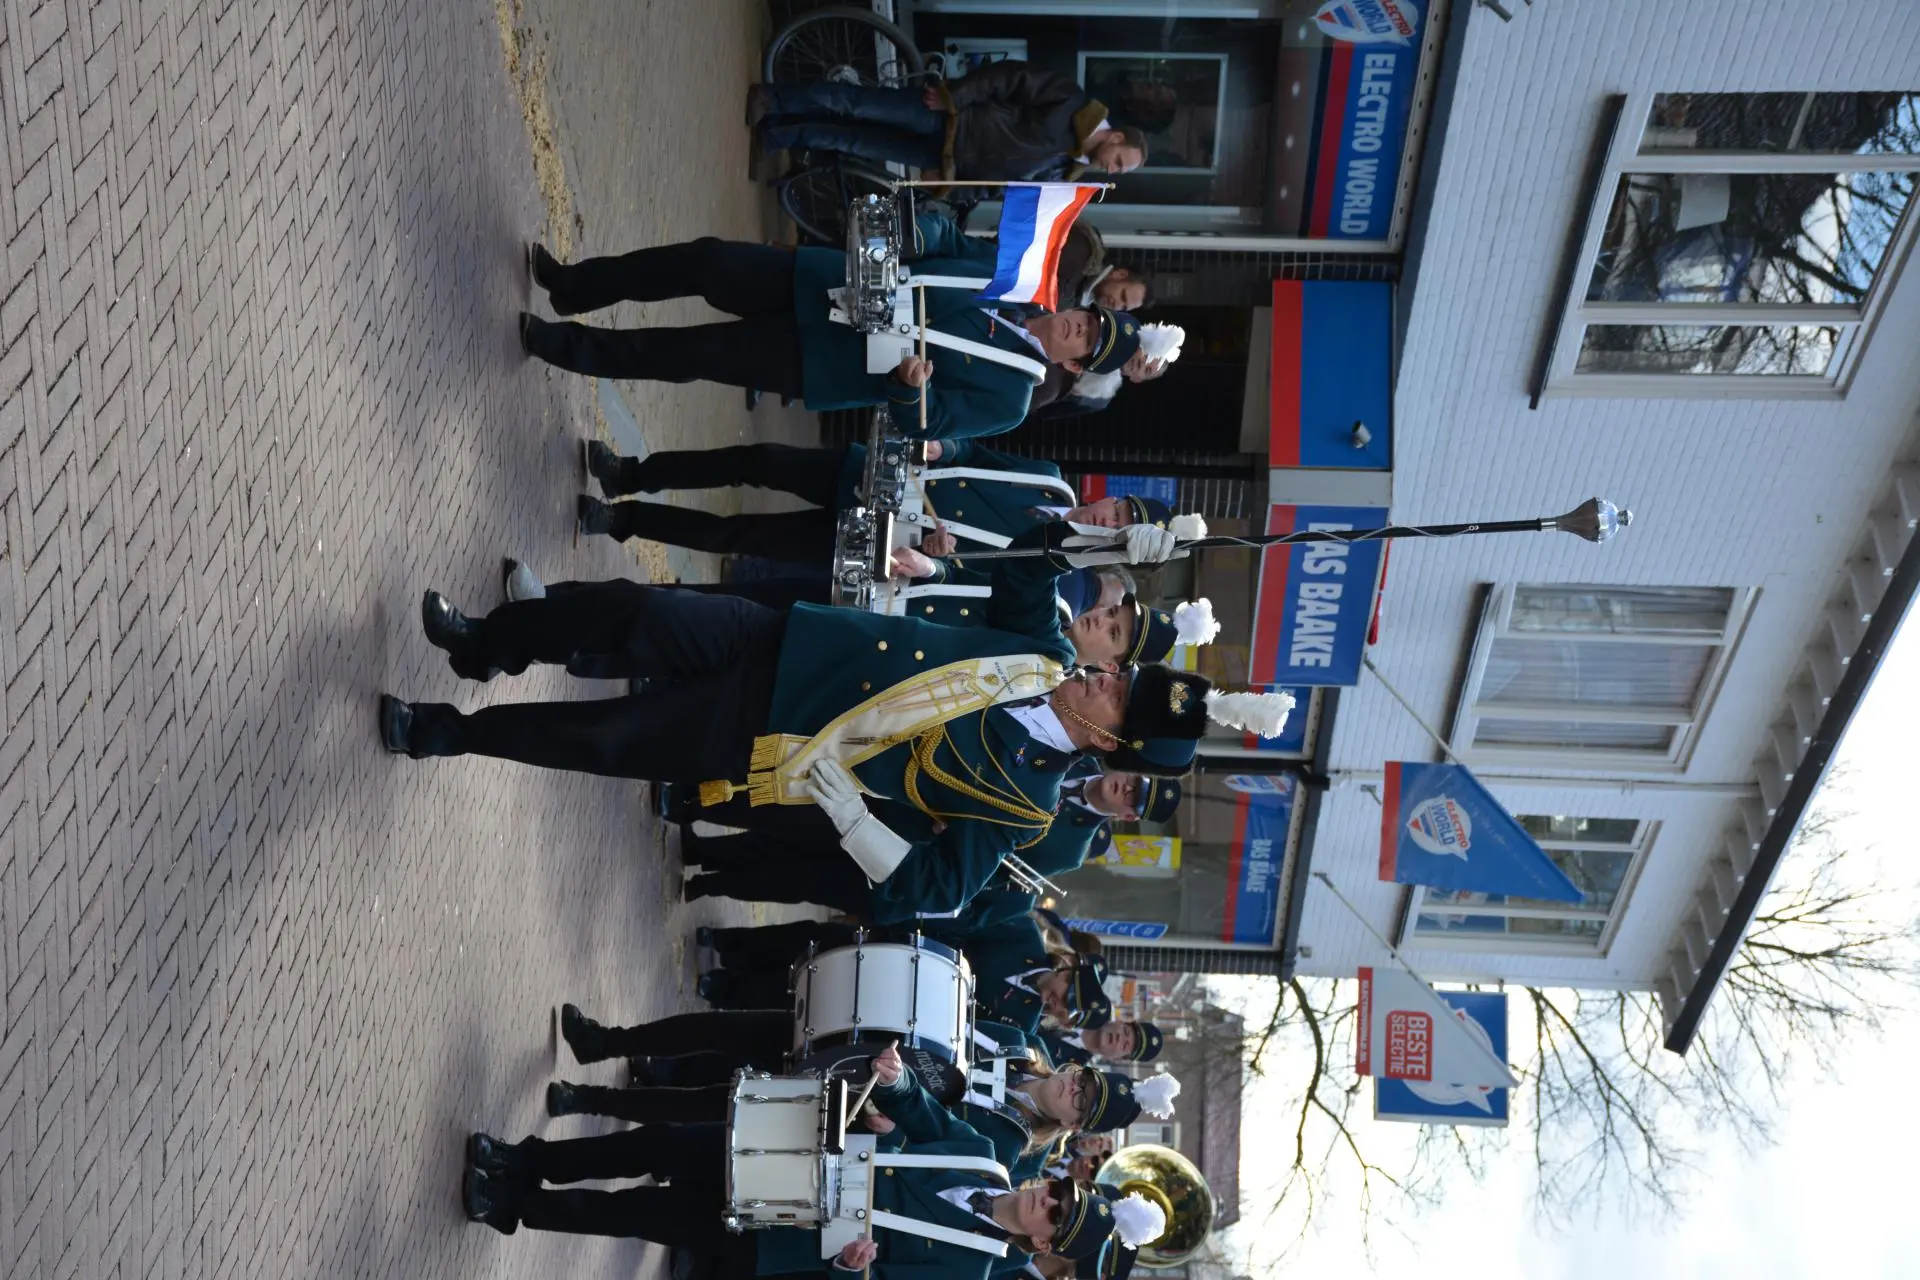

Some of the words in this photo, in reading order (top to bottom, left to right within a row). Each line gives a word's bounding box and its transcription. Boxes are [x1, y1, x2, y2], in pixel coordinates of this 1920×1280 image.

[1382, 0, 1413, 36] LECTRO
[1351, 53, 1397, 152] ELECTRO
[1339, 158, 1379, 235] WORLD
[1289, 582, 1344, 668] BAAKE
[1431, 803, 1456, 845] WORLD
[1446, 801, 1469, 848] ELECTRO
[1250, 839, 1273, 859] BAS
[1246, 861, 1270, 893] BAAKE
[1390, 1014, 1406, 1074] SELECTIE
[1407, 1016, 1427, 1075] BESTE
[914, 1051, 946, 1091] majestic
